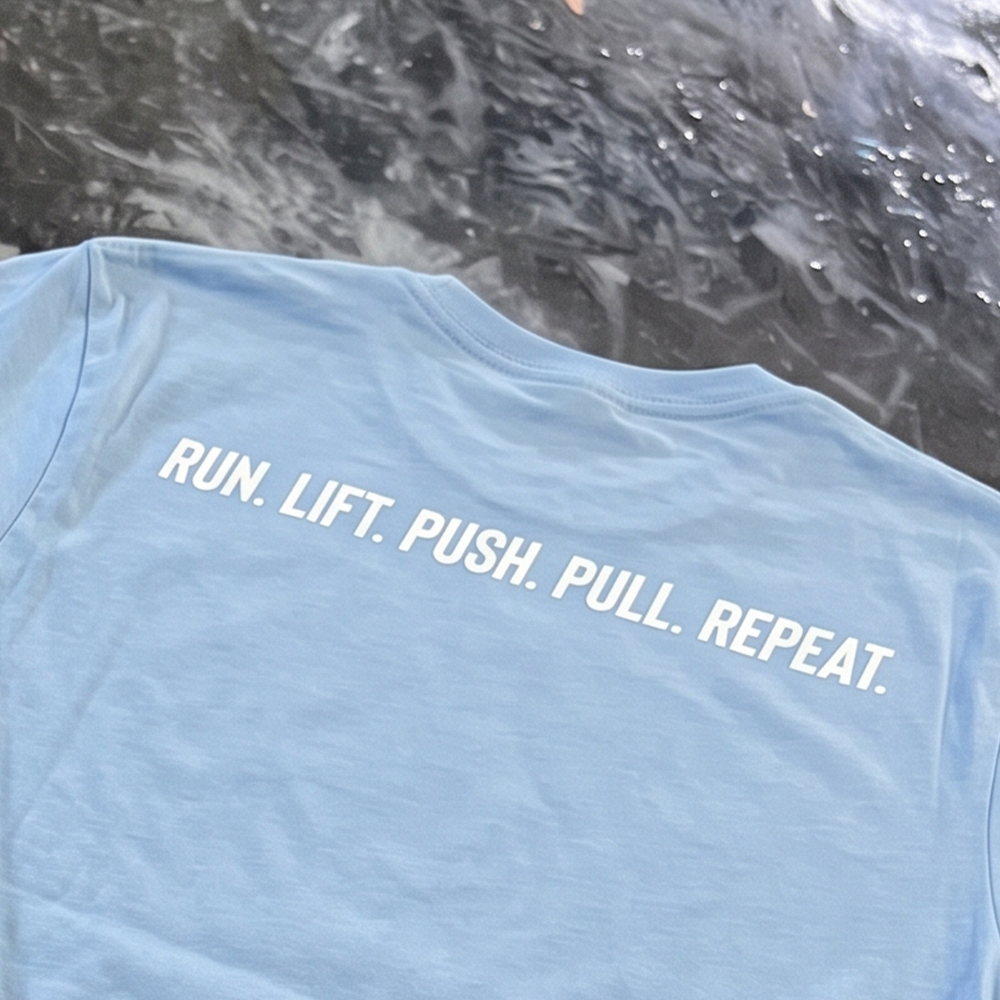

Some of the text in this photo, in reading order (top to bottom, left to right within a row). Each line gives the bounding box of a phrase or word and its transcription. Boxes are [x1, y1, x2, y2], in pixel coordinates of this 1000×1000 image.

[158, 437, 895, 695] RUN. LIFT. PUSH. PULL. REPEAT.
